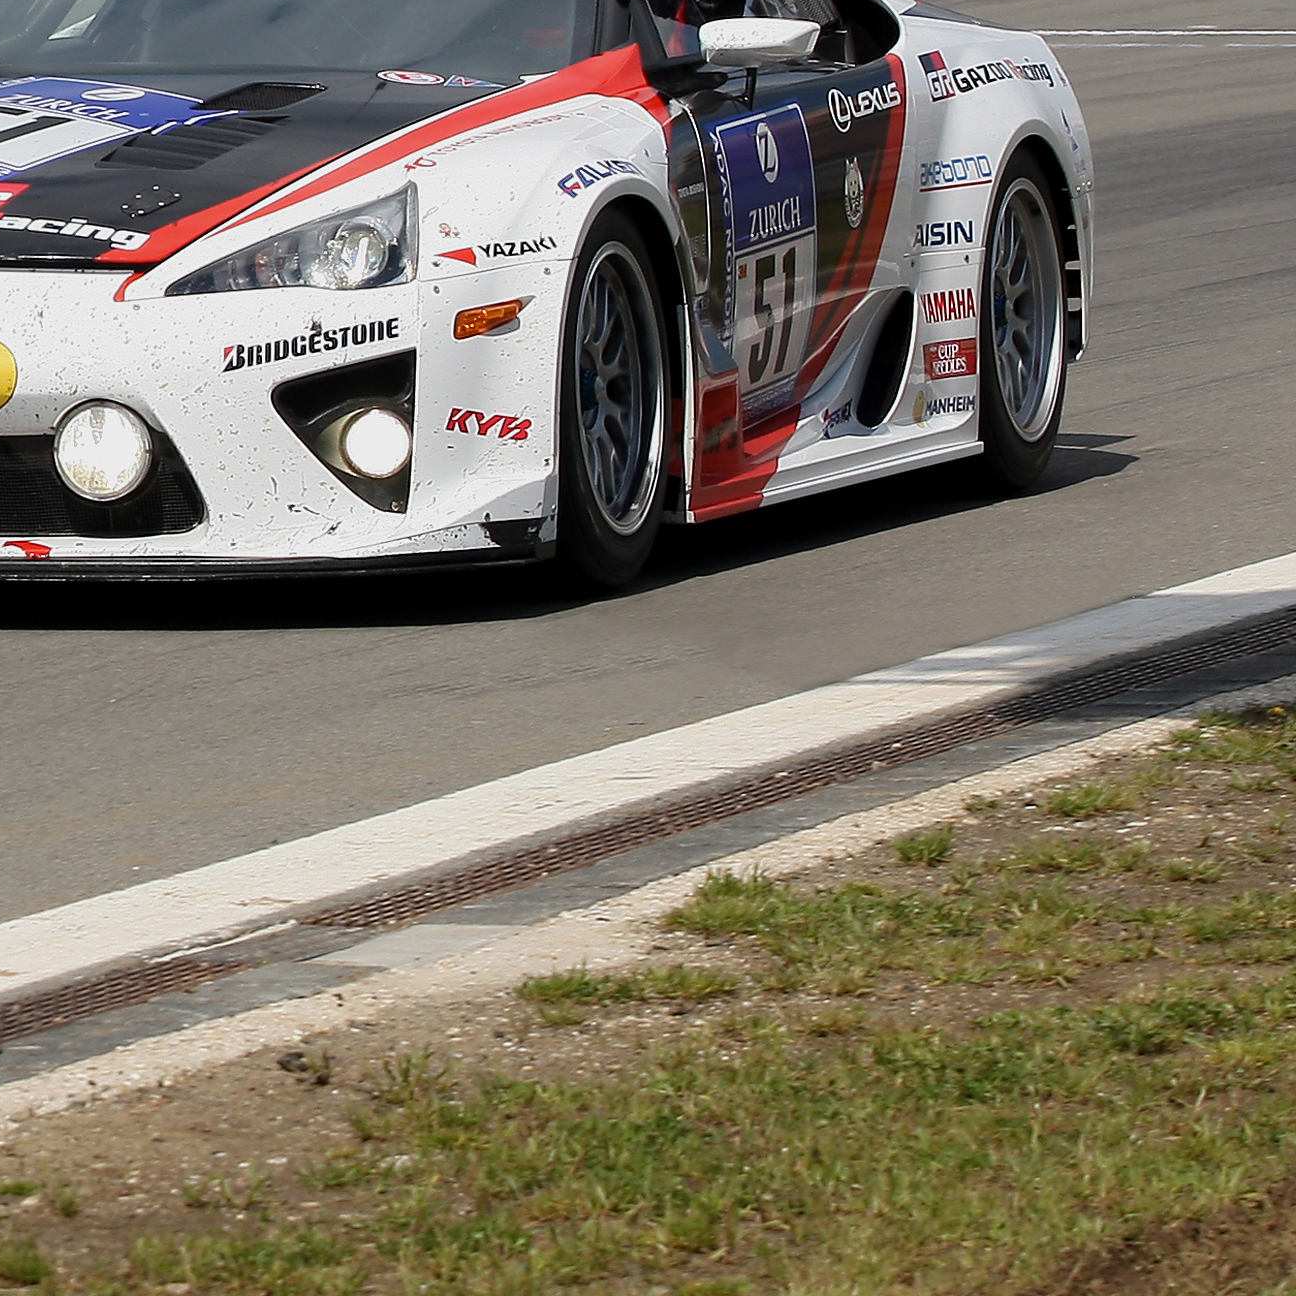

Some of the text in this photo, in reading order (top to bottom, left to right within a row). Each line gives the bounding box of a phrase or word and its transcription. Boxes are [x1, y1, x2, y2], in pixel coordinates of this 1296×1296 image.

[952, 62, 1013, 93] GAZOO
[851, 82, 901, 117] LEXUS
[748, 196, 802, 243] ZURICH
[912, 220, 974, 247] AISIN
[476, 235, 558, 259] YAZAKI
[749, 247, 796, 385] 51
[919, 287, 976, 324] YAMAHA
[221, 317, 400, 372] BRIDGESTONE
[938, 344, 959, 359] CUP
[926, 396, 976, 415] MANHEIM
[446, 408, 532, 442] KYB
